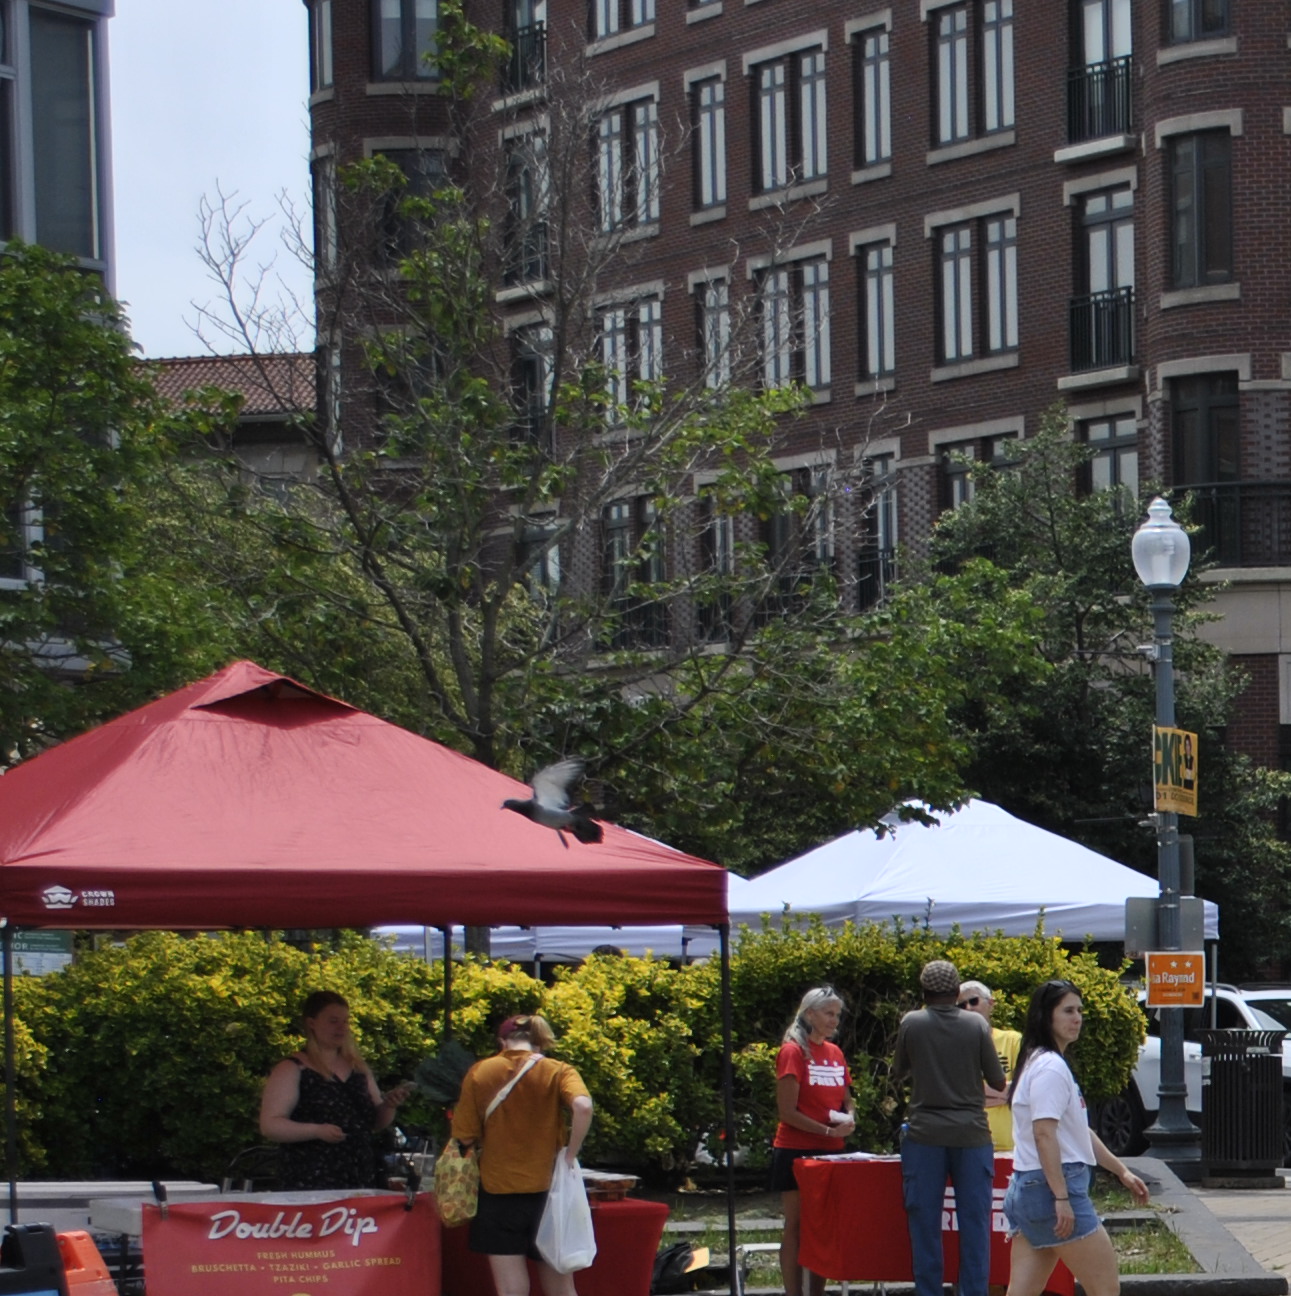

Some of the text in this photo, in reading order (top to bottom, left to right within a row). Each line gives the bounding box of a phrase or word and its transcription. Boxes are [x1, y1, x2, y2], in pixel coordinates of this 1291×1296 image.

[208, 1206, 378, 1246] Double Dip
[257, 1249, 336, 1260] FRESH HUMMUS
[191, 1257, 402, 1273] BRUSCHETTA TZAZIKI GARLIC SPREAD
[273, 1275, 329, 1283] PITA CHIPS
